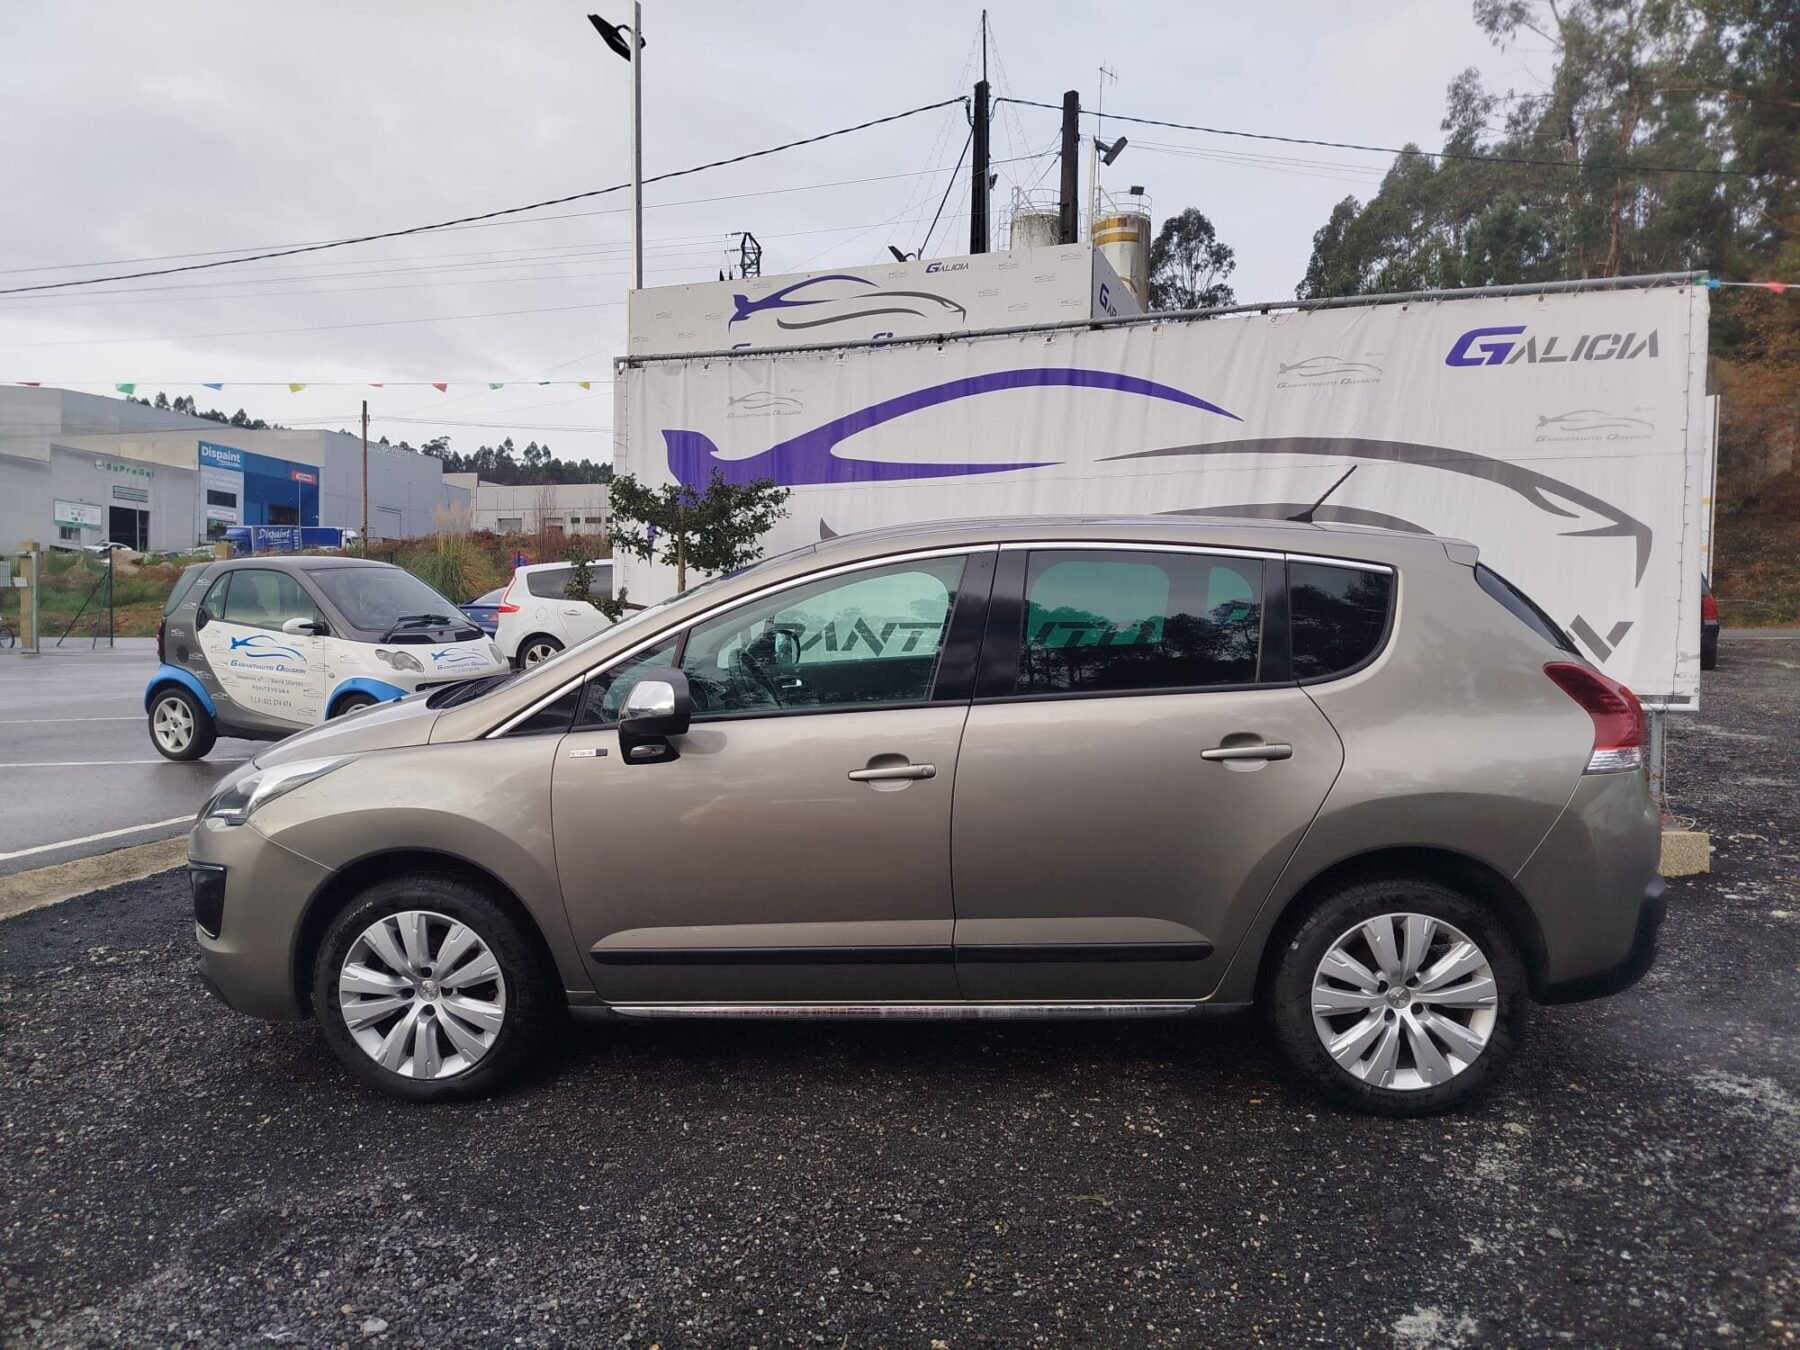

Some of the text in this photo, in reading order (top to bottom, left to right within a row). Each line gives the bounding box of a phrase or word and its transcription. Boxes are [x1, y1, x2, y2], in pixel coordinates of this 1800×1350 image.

[925, 261, 969, 273] GALICIA
[1445, 325, 1659, 367] GALICIA
[201, 446, 241, 466] Dispaint
